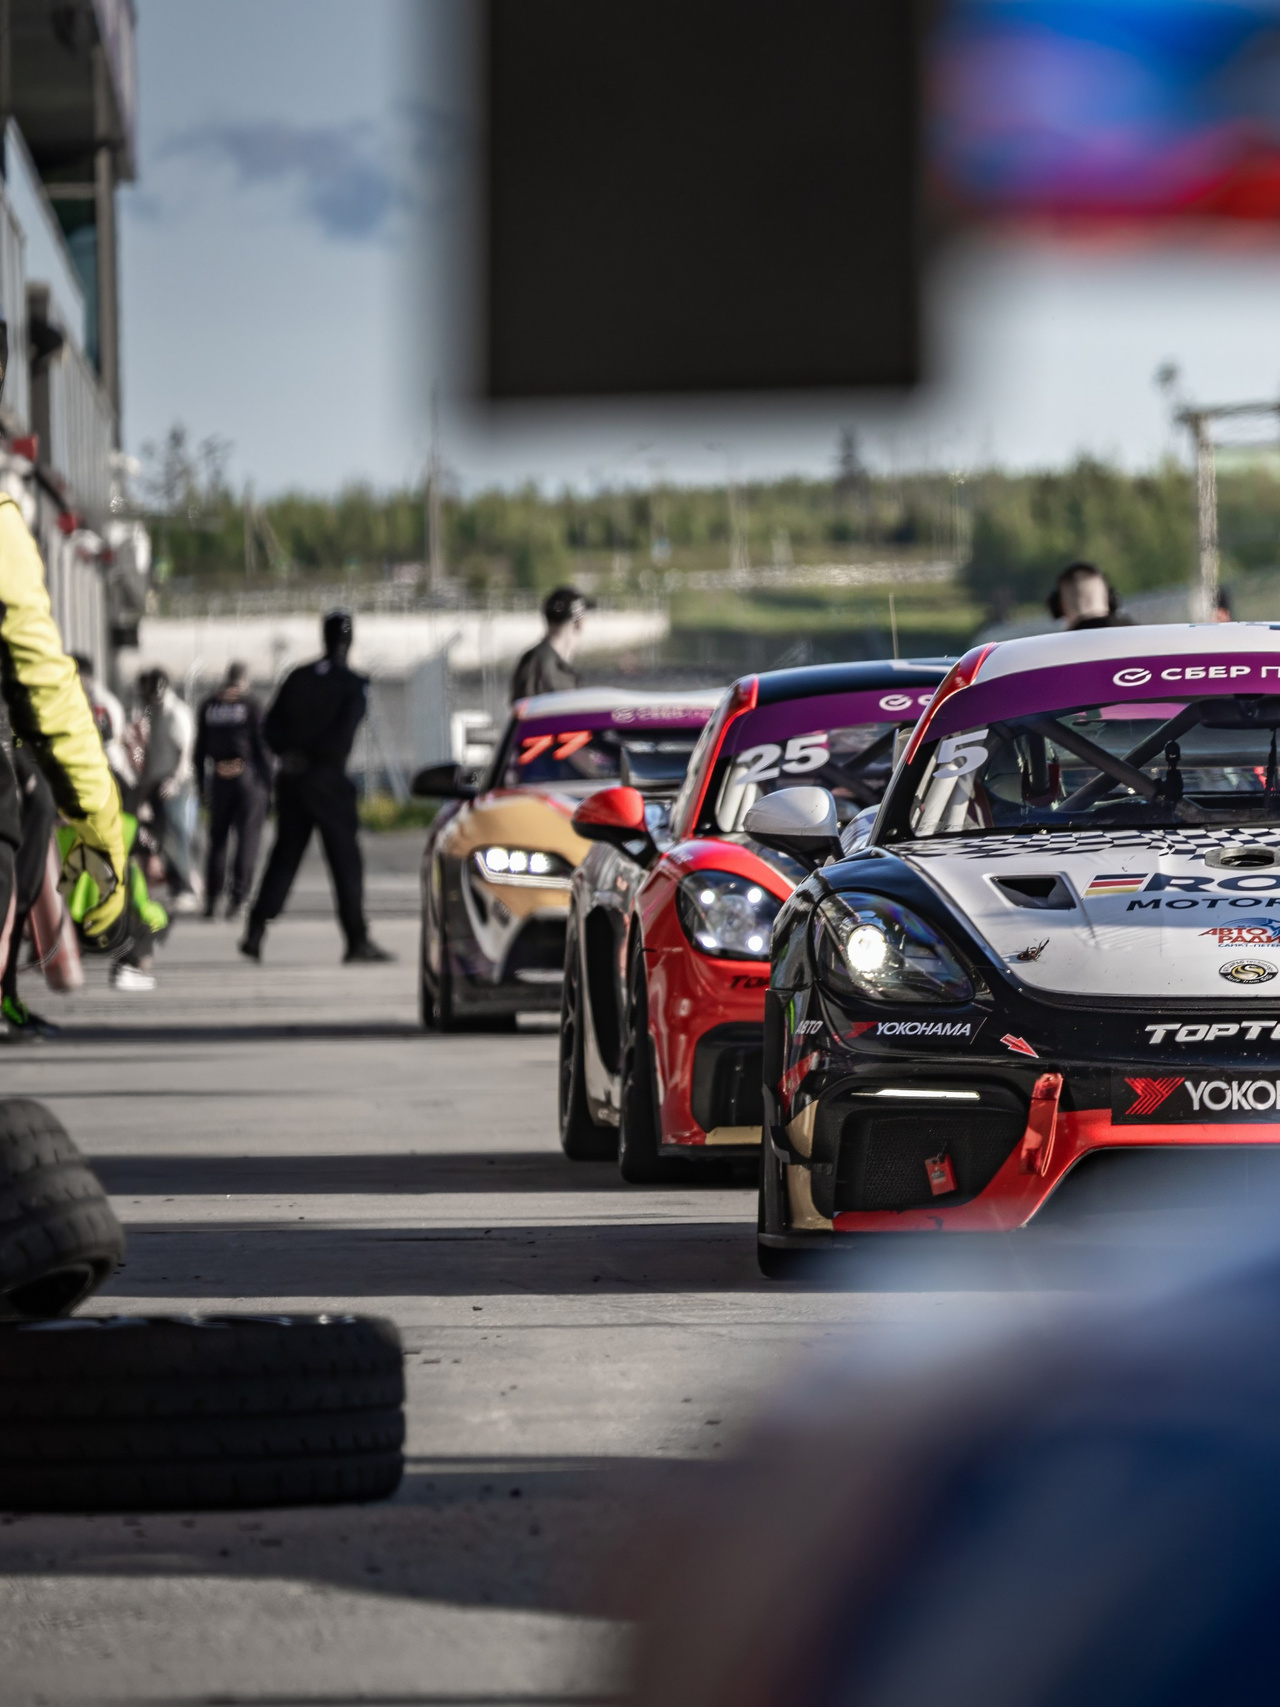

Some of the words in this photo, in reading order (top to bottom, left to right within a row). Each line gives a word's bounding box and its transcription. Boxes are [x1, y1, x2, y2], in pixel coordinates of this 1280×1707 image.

[1160, 665, 1251, 680] СБЕР
[518, 731, 594, 766] 77
[933, 728, 989, 779] 5
[734, 733, 831, 785] 25
[1198, 927, 1268, 936] АВТО
[795, 1021, 823, 1035] АВТО
[876, 1021, 972, 1037] YOKOHAMA
